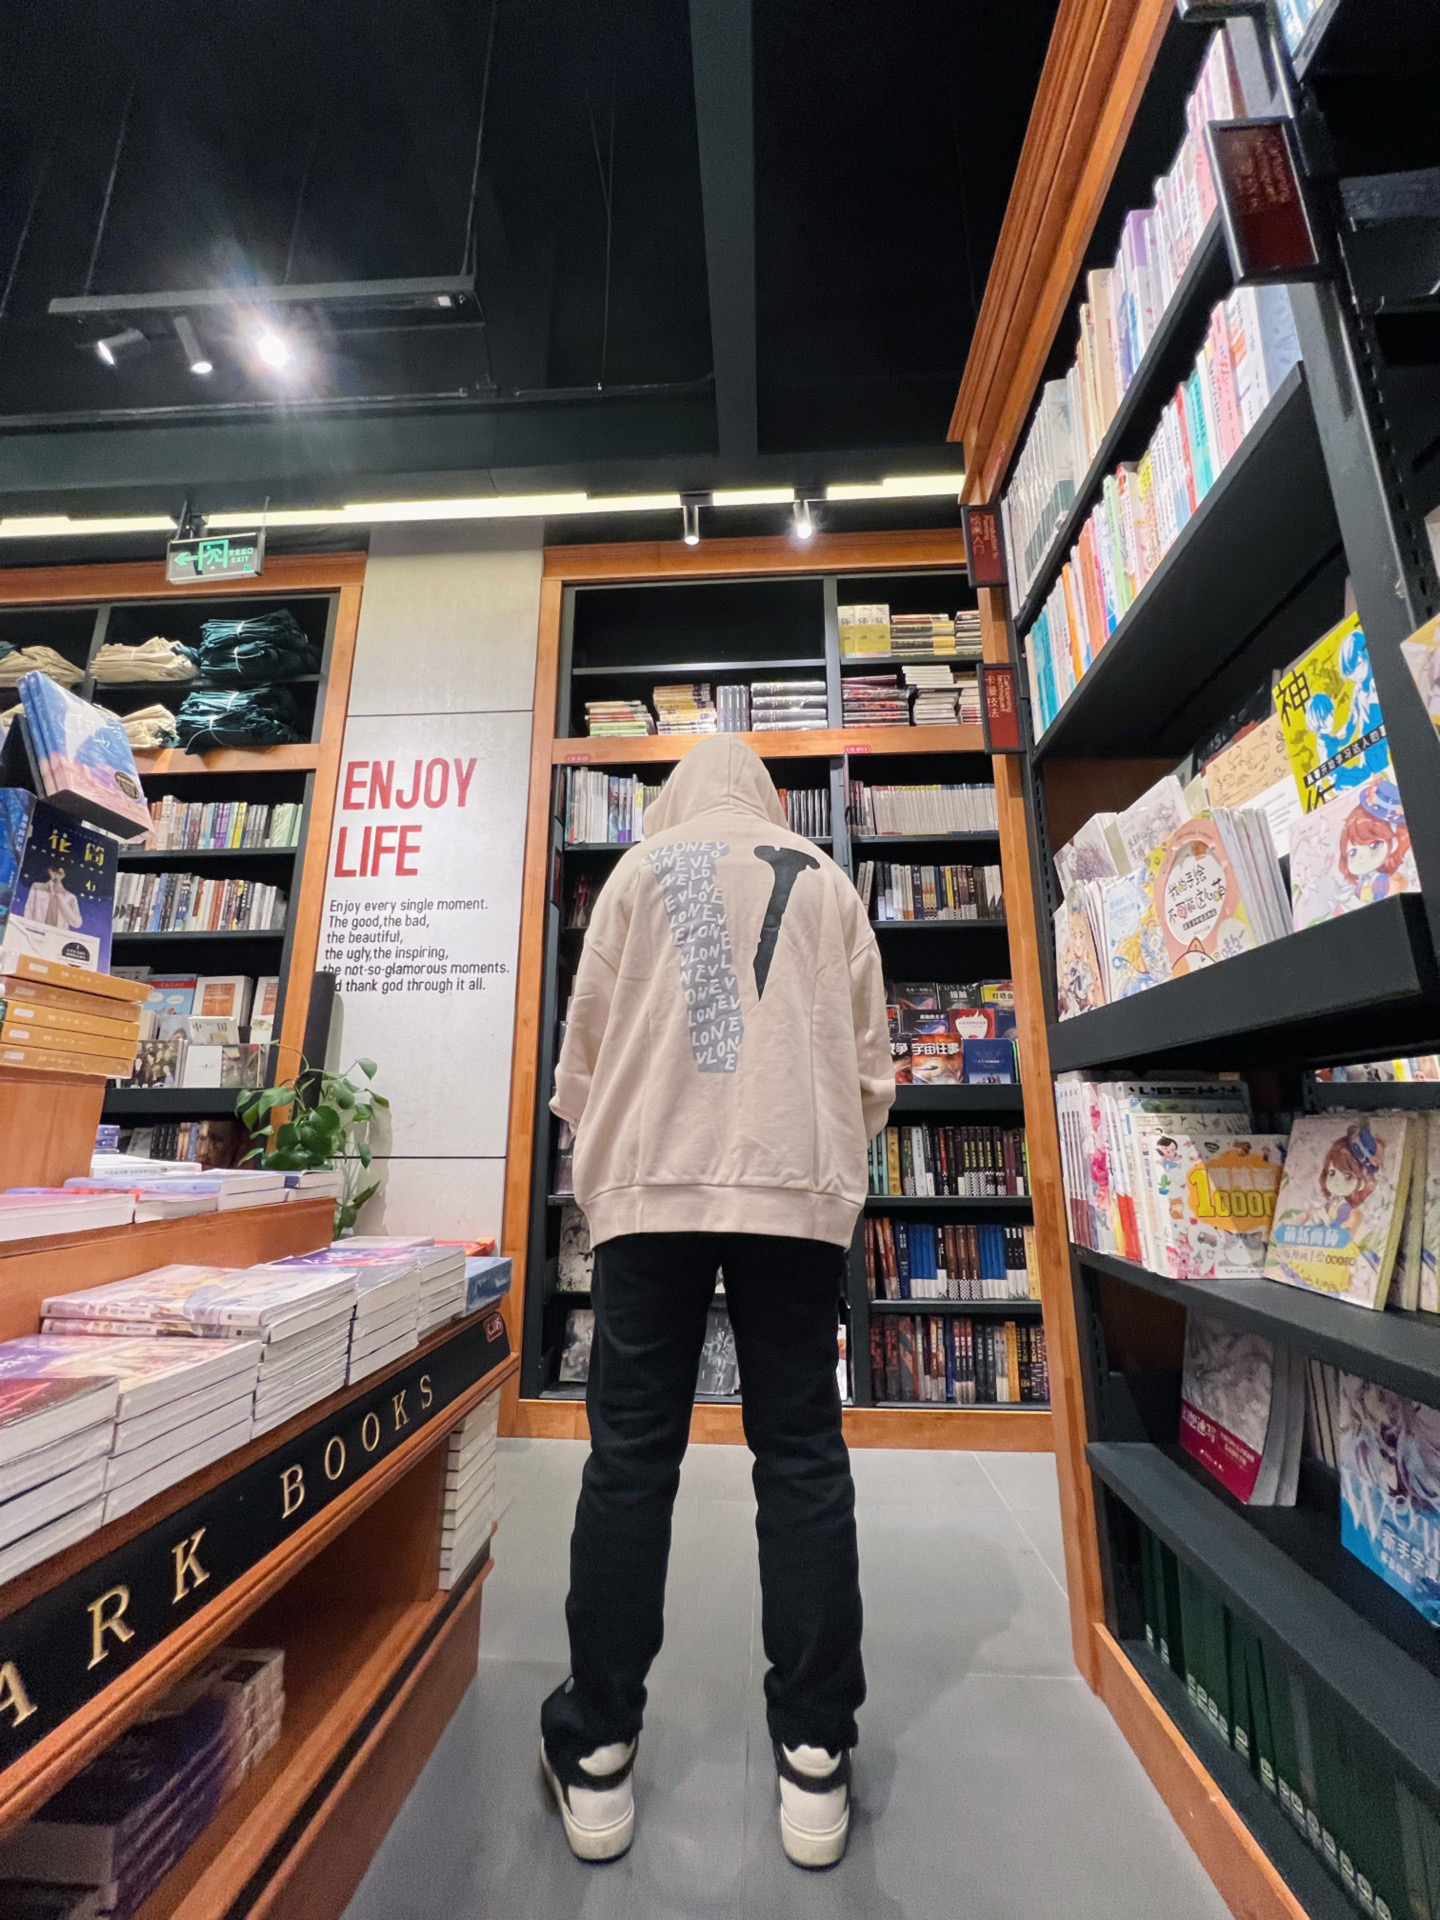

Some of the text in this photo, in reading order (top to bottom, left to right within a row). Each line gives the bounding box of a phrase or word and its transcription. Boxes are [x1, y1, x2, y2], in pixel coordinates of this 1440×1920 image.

[231, 555, 250, 564] EXIT
[1003, 674, 1012, 713] Cartooning
[1275, 669, 1312, 727] 神
[342, 757, 478, 811] ENJOY
[334, 824, 423, 878] LIFE
[1167, 864, 1208, 901] 我的手绘
[329, 898, 488, 915] Enjoy every single moment.
[328, 915, 348, 928] The
[404, 914, 430, 929] bad,
[326, 930, 404, 944] the beautiful,
[325, 946, 343, 960] the
[394, 945, 449, 961] inspiring,
[322, 961, 510, 978] the not-so-glamorous moments.
[345, 979, 378, 992] thank
[381, 978, 403, 994] god
[407, 977, 453, 994] through
[456, 977, 465, 991] it
[468, 977, 486, 991] all.
[911, 1042, 960, 1056] 宇宙往事
[280, 1373, 434, 1519] BOOKS
